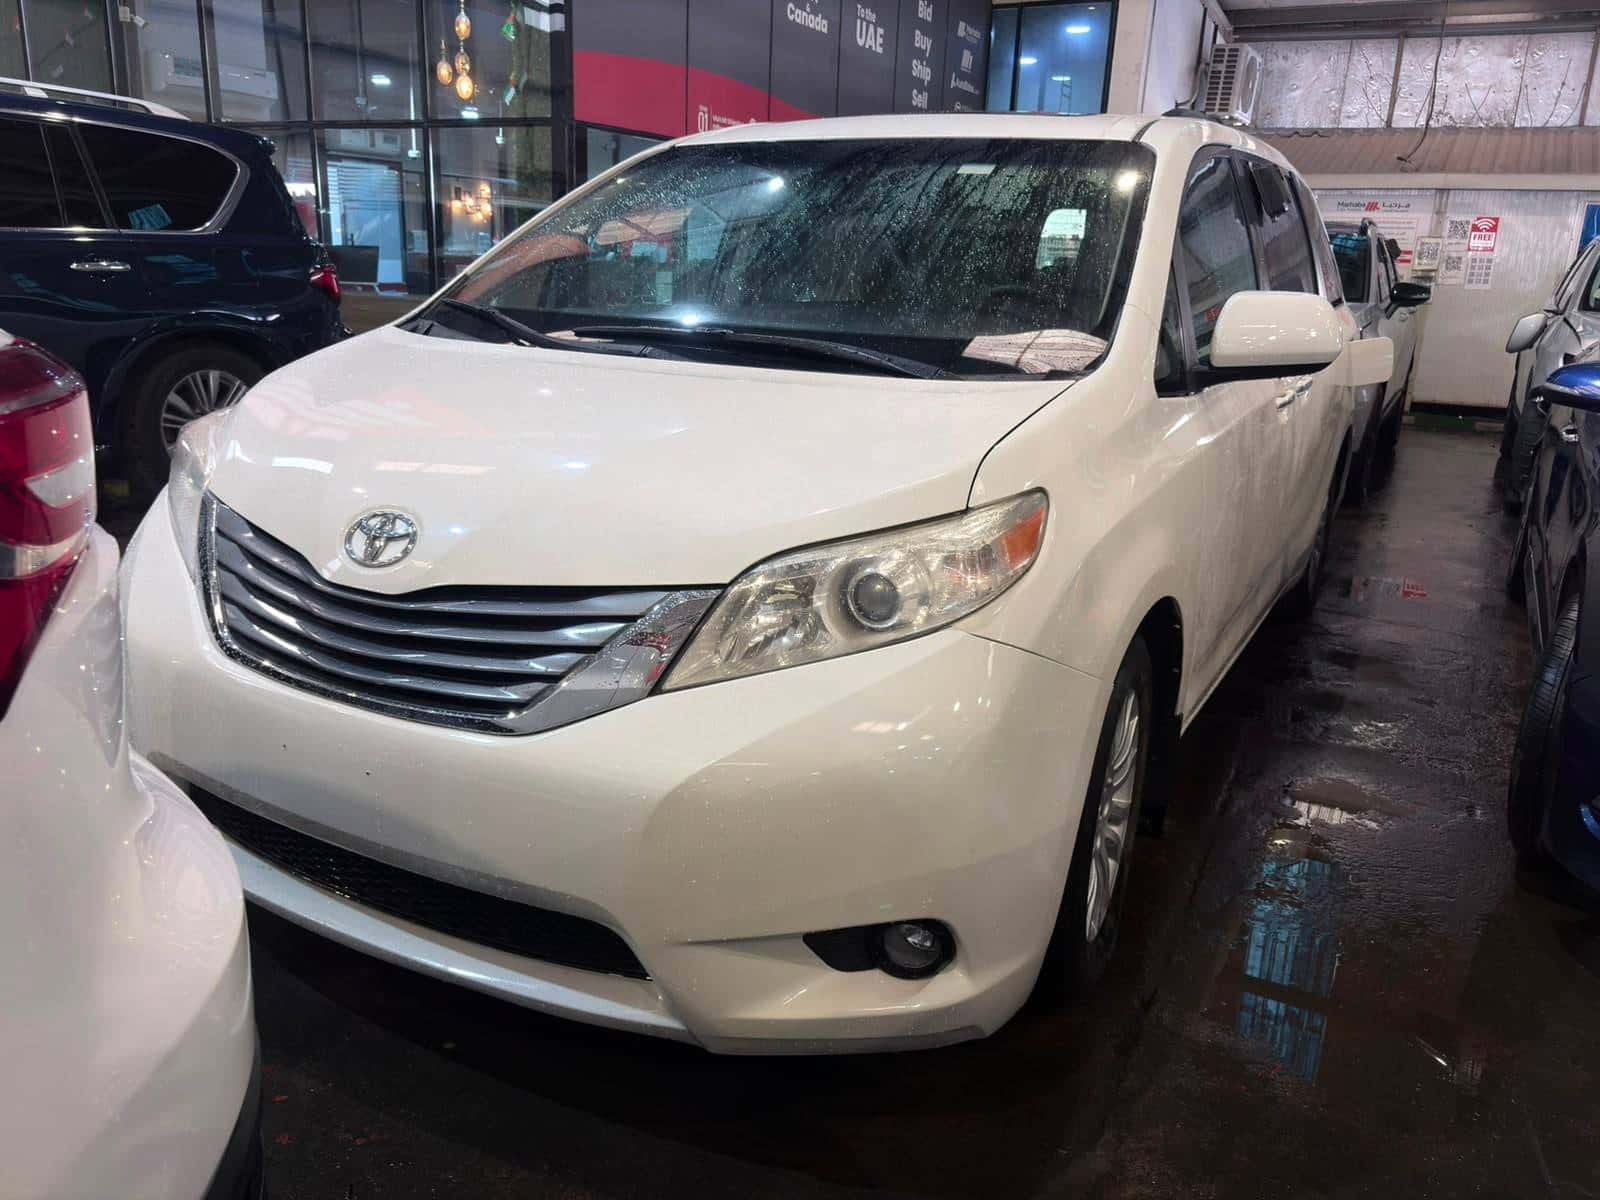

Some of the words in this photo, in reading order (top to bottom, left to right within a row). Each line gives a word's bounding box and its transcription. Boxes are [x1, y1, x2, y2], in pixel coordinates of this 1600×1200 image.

[787, 3, 828, 33] Canada
[856, 4, 865, 18] To
[865, 8, 876, 22] the
[918, 0, 933, 22] Bid
[856, 18, 884, 53] UAE
[914, 29, 932, 57] Buy
[911, 58, 931, 87] Ship
[912, 88, 928, 109] Sell
[697, 111, 708, 132] 01
[1472, 233, 1491, 241] FREE
